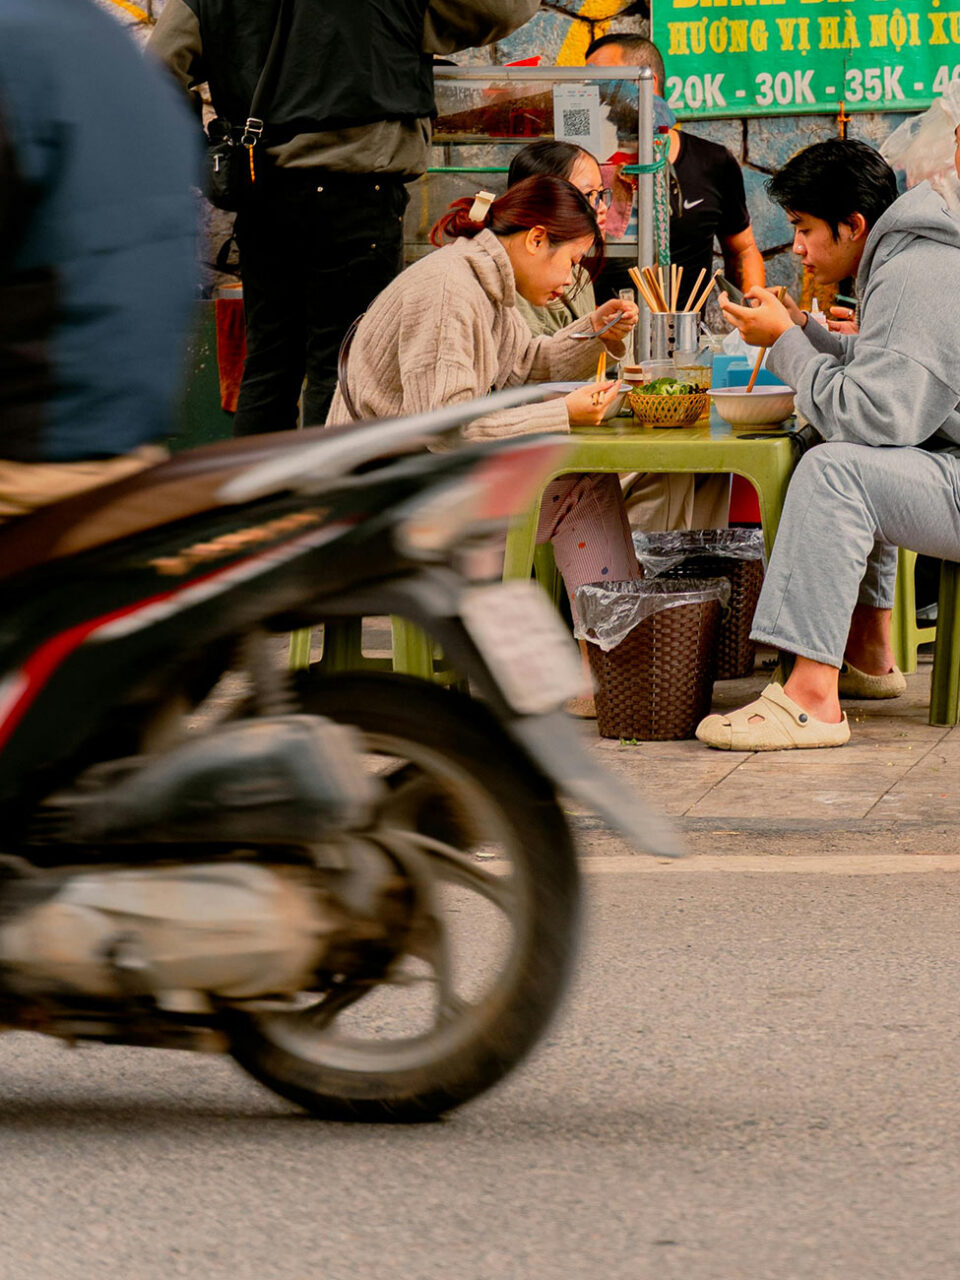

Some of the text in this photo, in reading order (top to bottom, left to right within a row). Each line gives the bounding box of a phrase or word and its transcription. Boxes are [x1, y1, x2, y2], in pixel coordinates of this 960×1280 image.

[667, 16, 769, 55] HƯƠNG
[775, 17, 811, 56] VỊ
[818, 9, 861, 49] HÀ
[868, 8, 921, 52] NỘI
[666, 73, 727, 109] 20K
[755, 70, 816, 106] 30K
[844, 66, 905, 102] 35K
